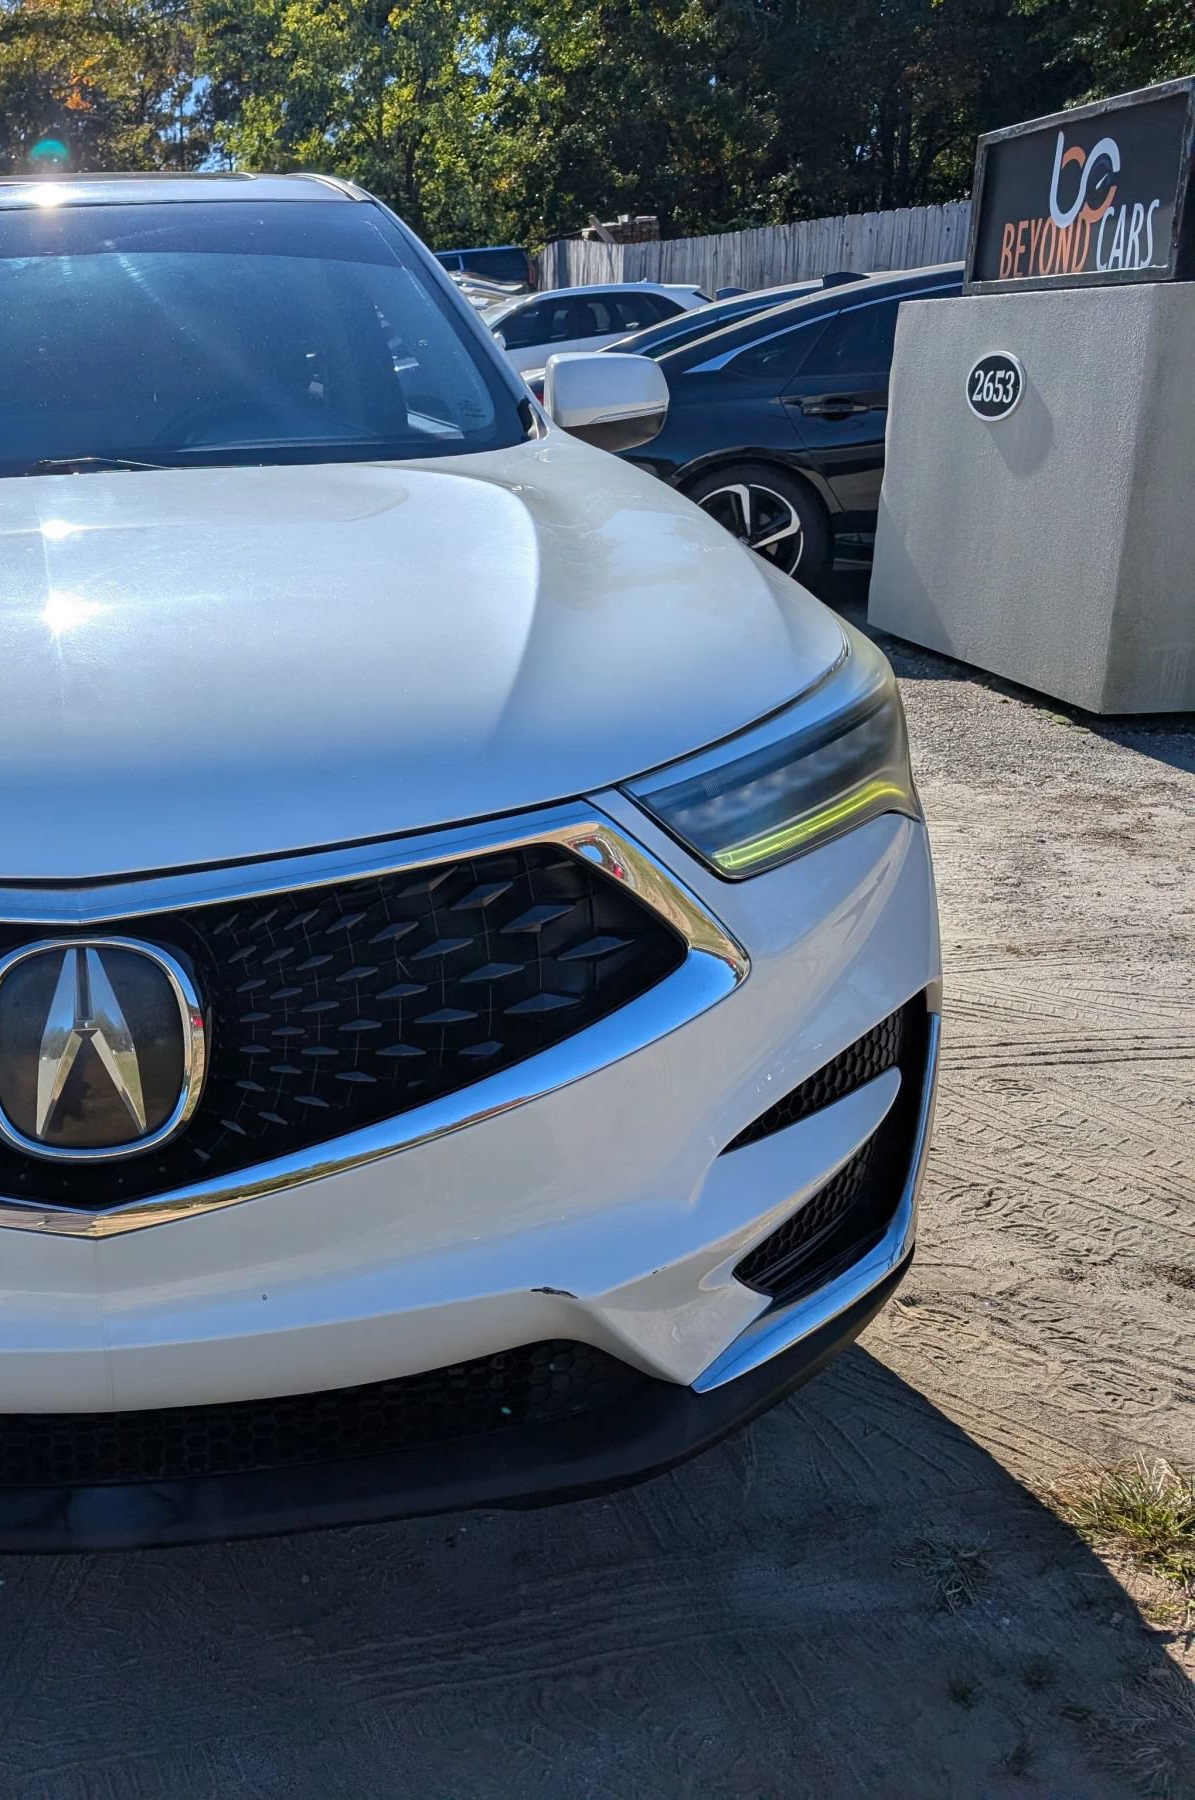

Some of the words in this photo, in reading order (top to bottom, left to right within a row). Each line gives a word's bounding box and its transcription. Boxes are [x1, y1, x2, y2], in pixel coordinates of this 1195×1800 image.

[999, 214, 1091, 280] BEYOND
[1096, 199, 1161, 271] CARS
[971, 369, 1016, 403] 2653
